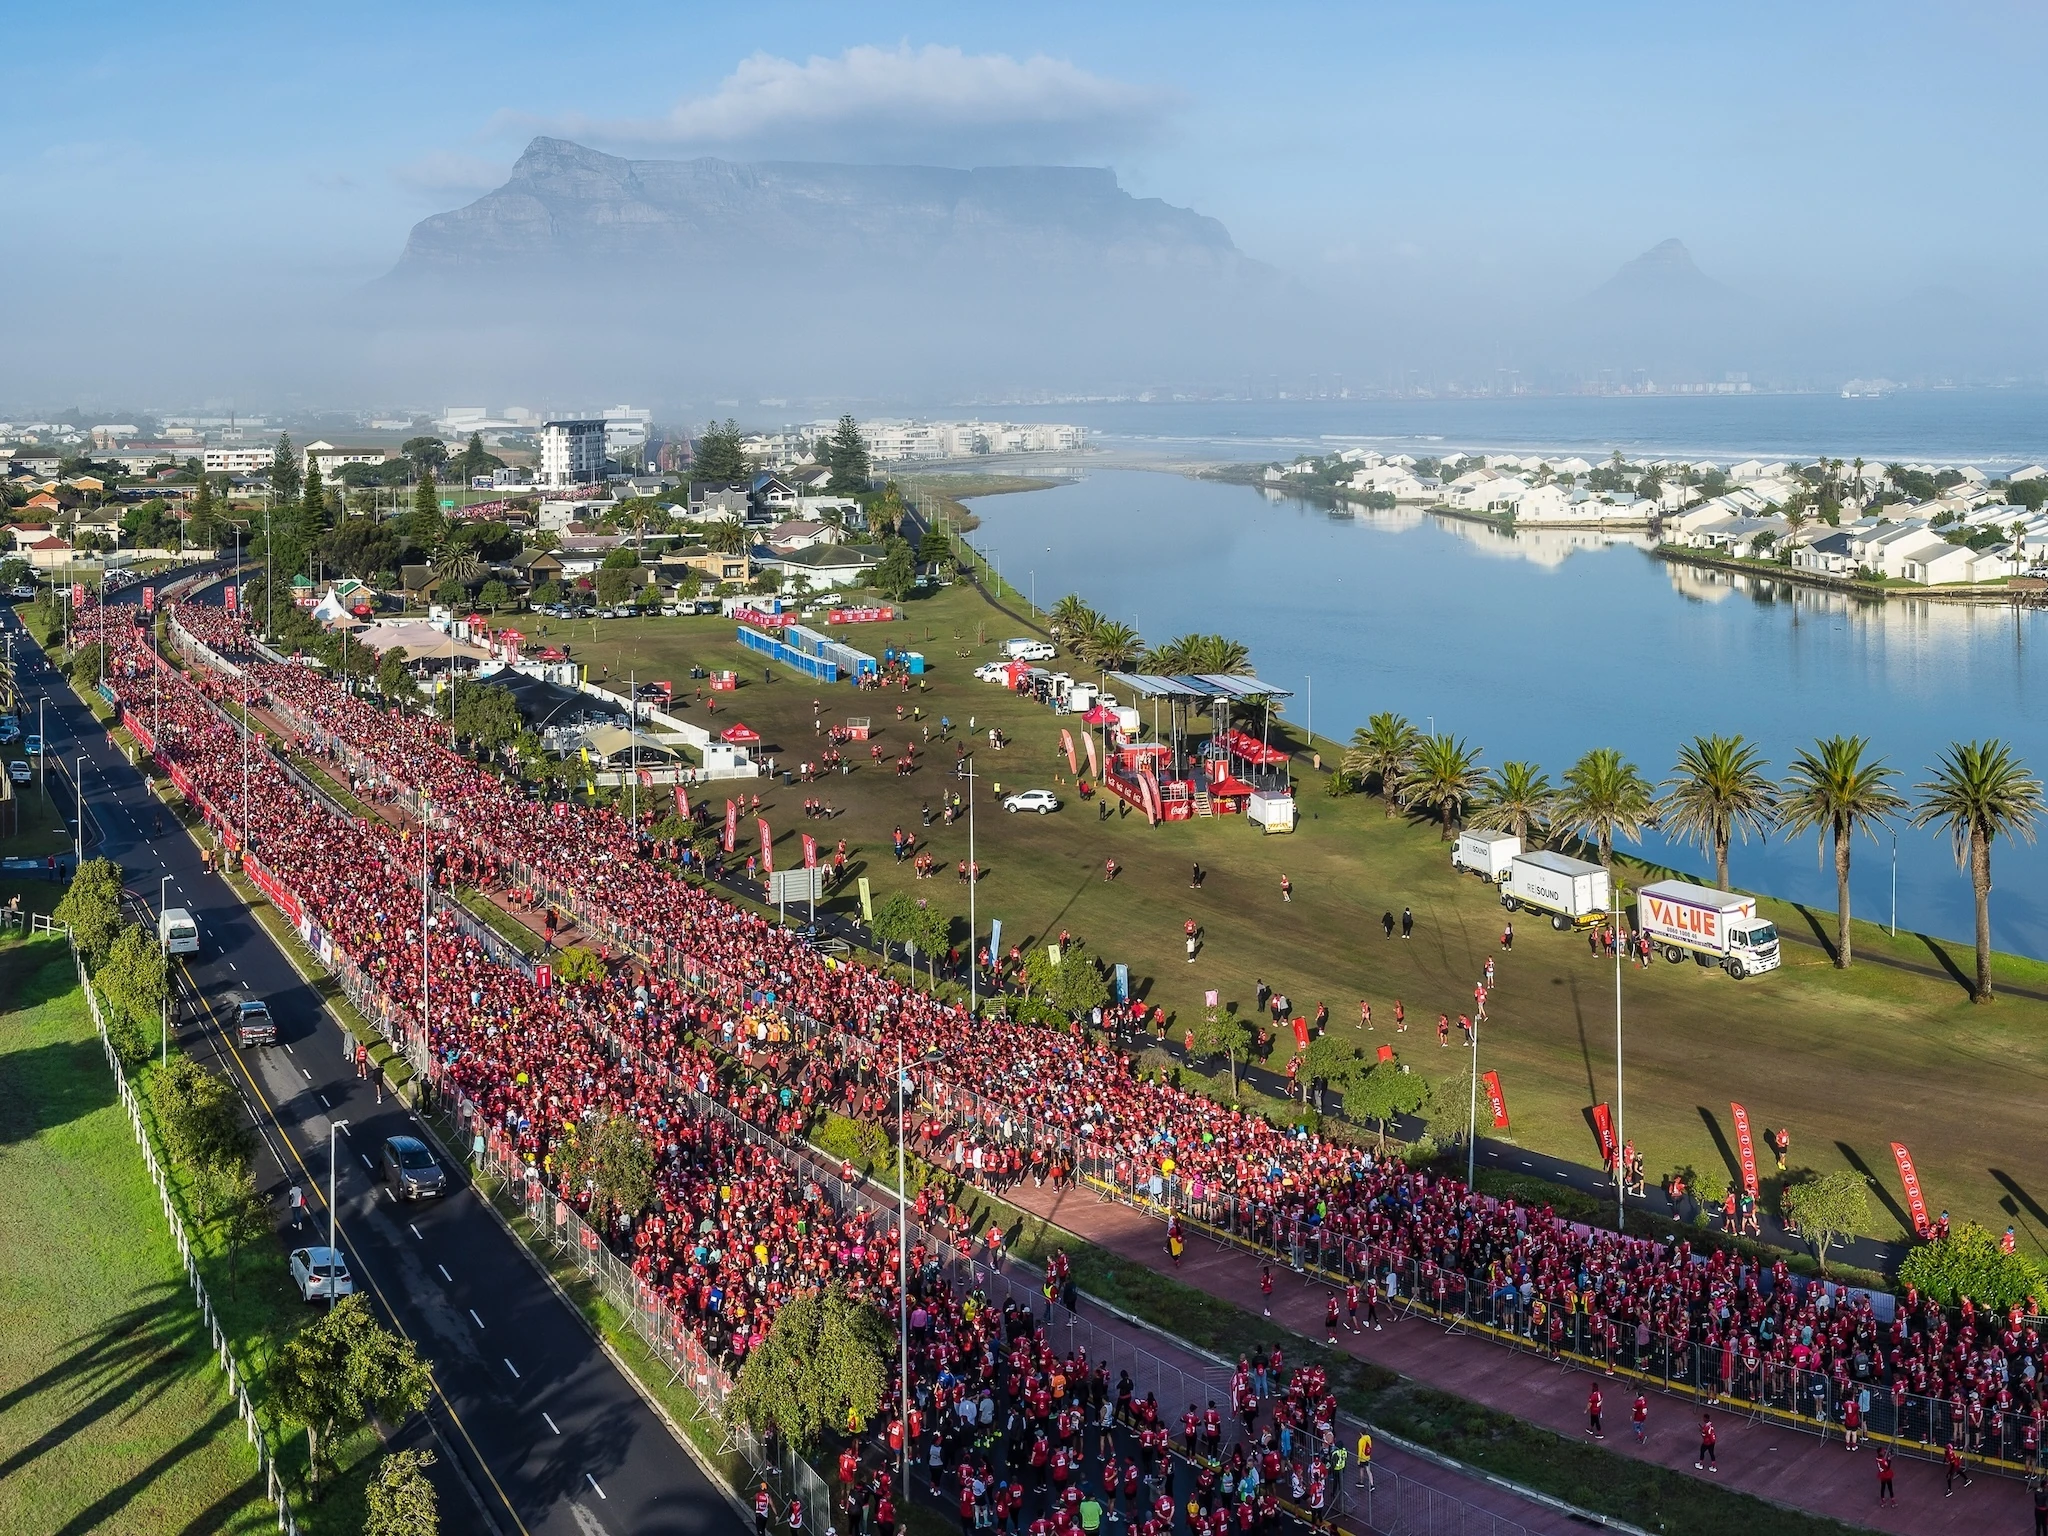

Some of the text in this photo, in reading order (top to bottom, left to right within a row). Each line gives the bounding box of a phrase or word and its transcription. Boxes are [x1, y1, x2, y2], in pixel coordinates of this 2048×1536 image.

[304, 598, 322, 606] CITY
[1649, 899, 1716, 936] VALUE
[1492, 1097, 1503, 1118] AVIS
[1602, 1129, 1613, 1149] AVIS
